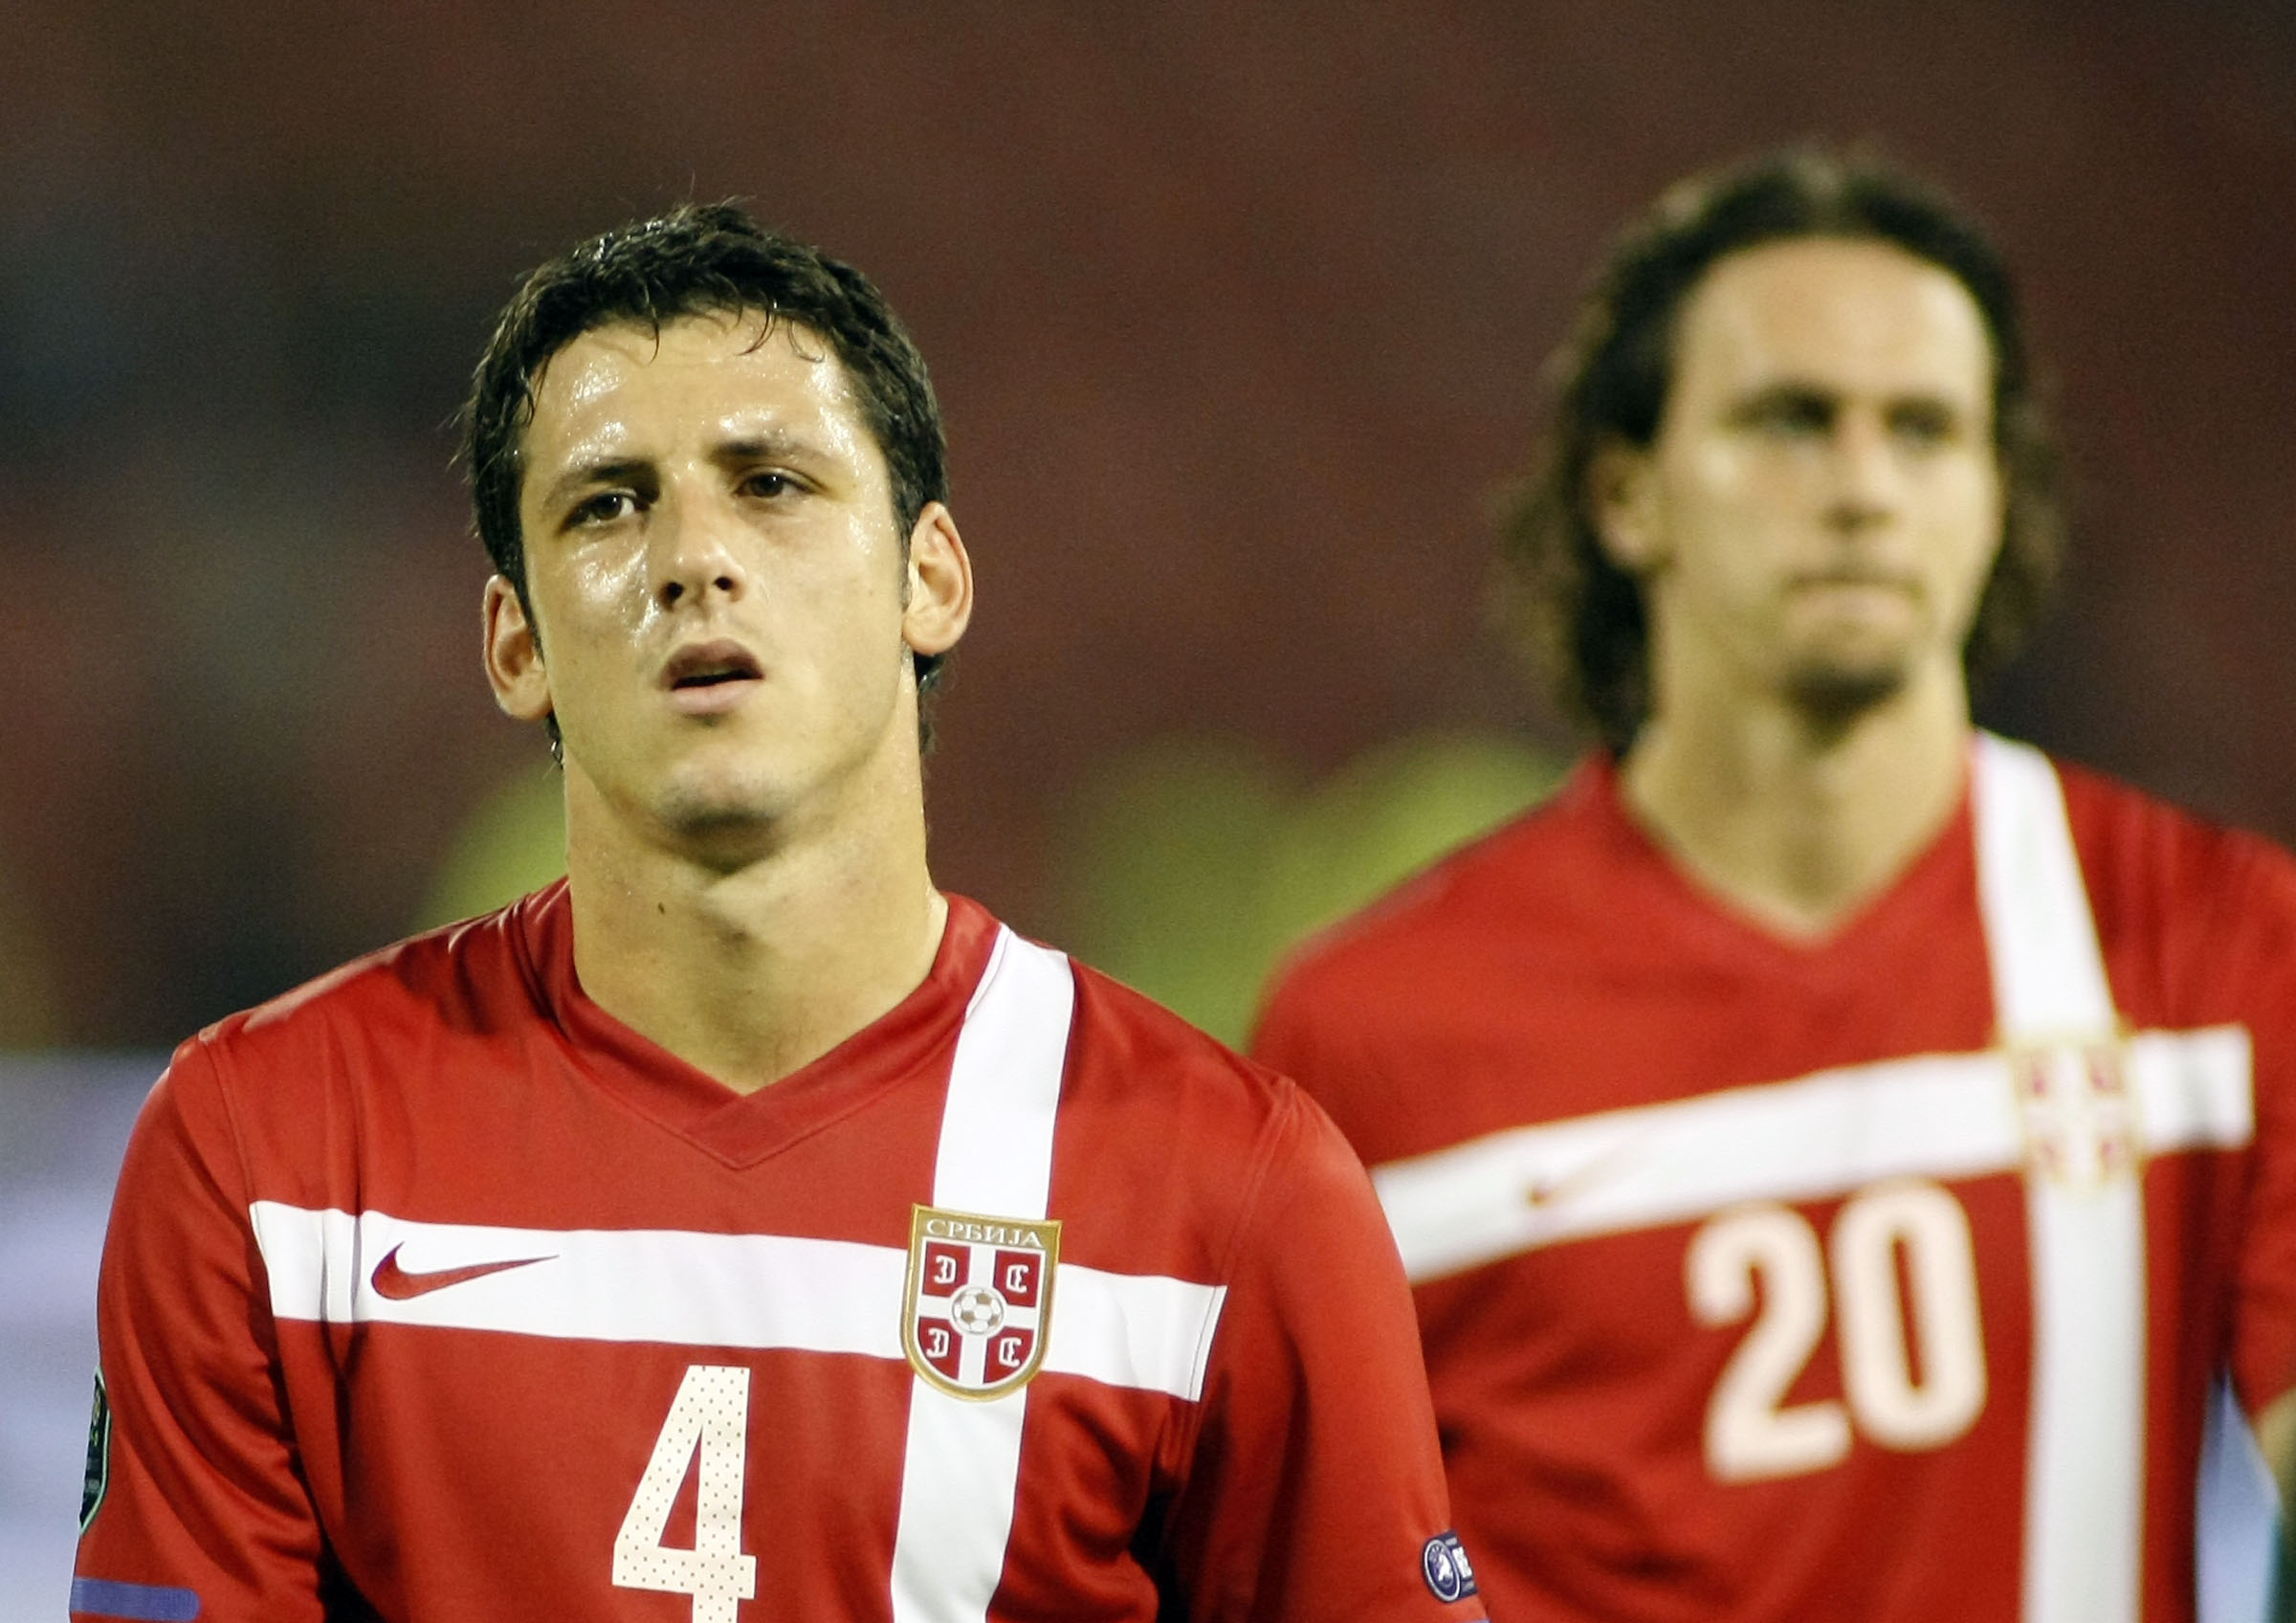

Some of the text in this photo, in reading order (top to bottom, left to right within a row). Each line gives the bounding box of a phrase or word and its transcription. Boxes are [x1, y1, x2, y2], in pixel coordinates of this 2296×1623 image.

[926, 1218, 1043, 1247] СРБИЈА
[1683, 1178, 1989, 1485] 20
[612, 1365, 757, 1623] 4
